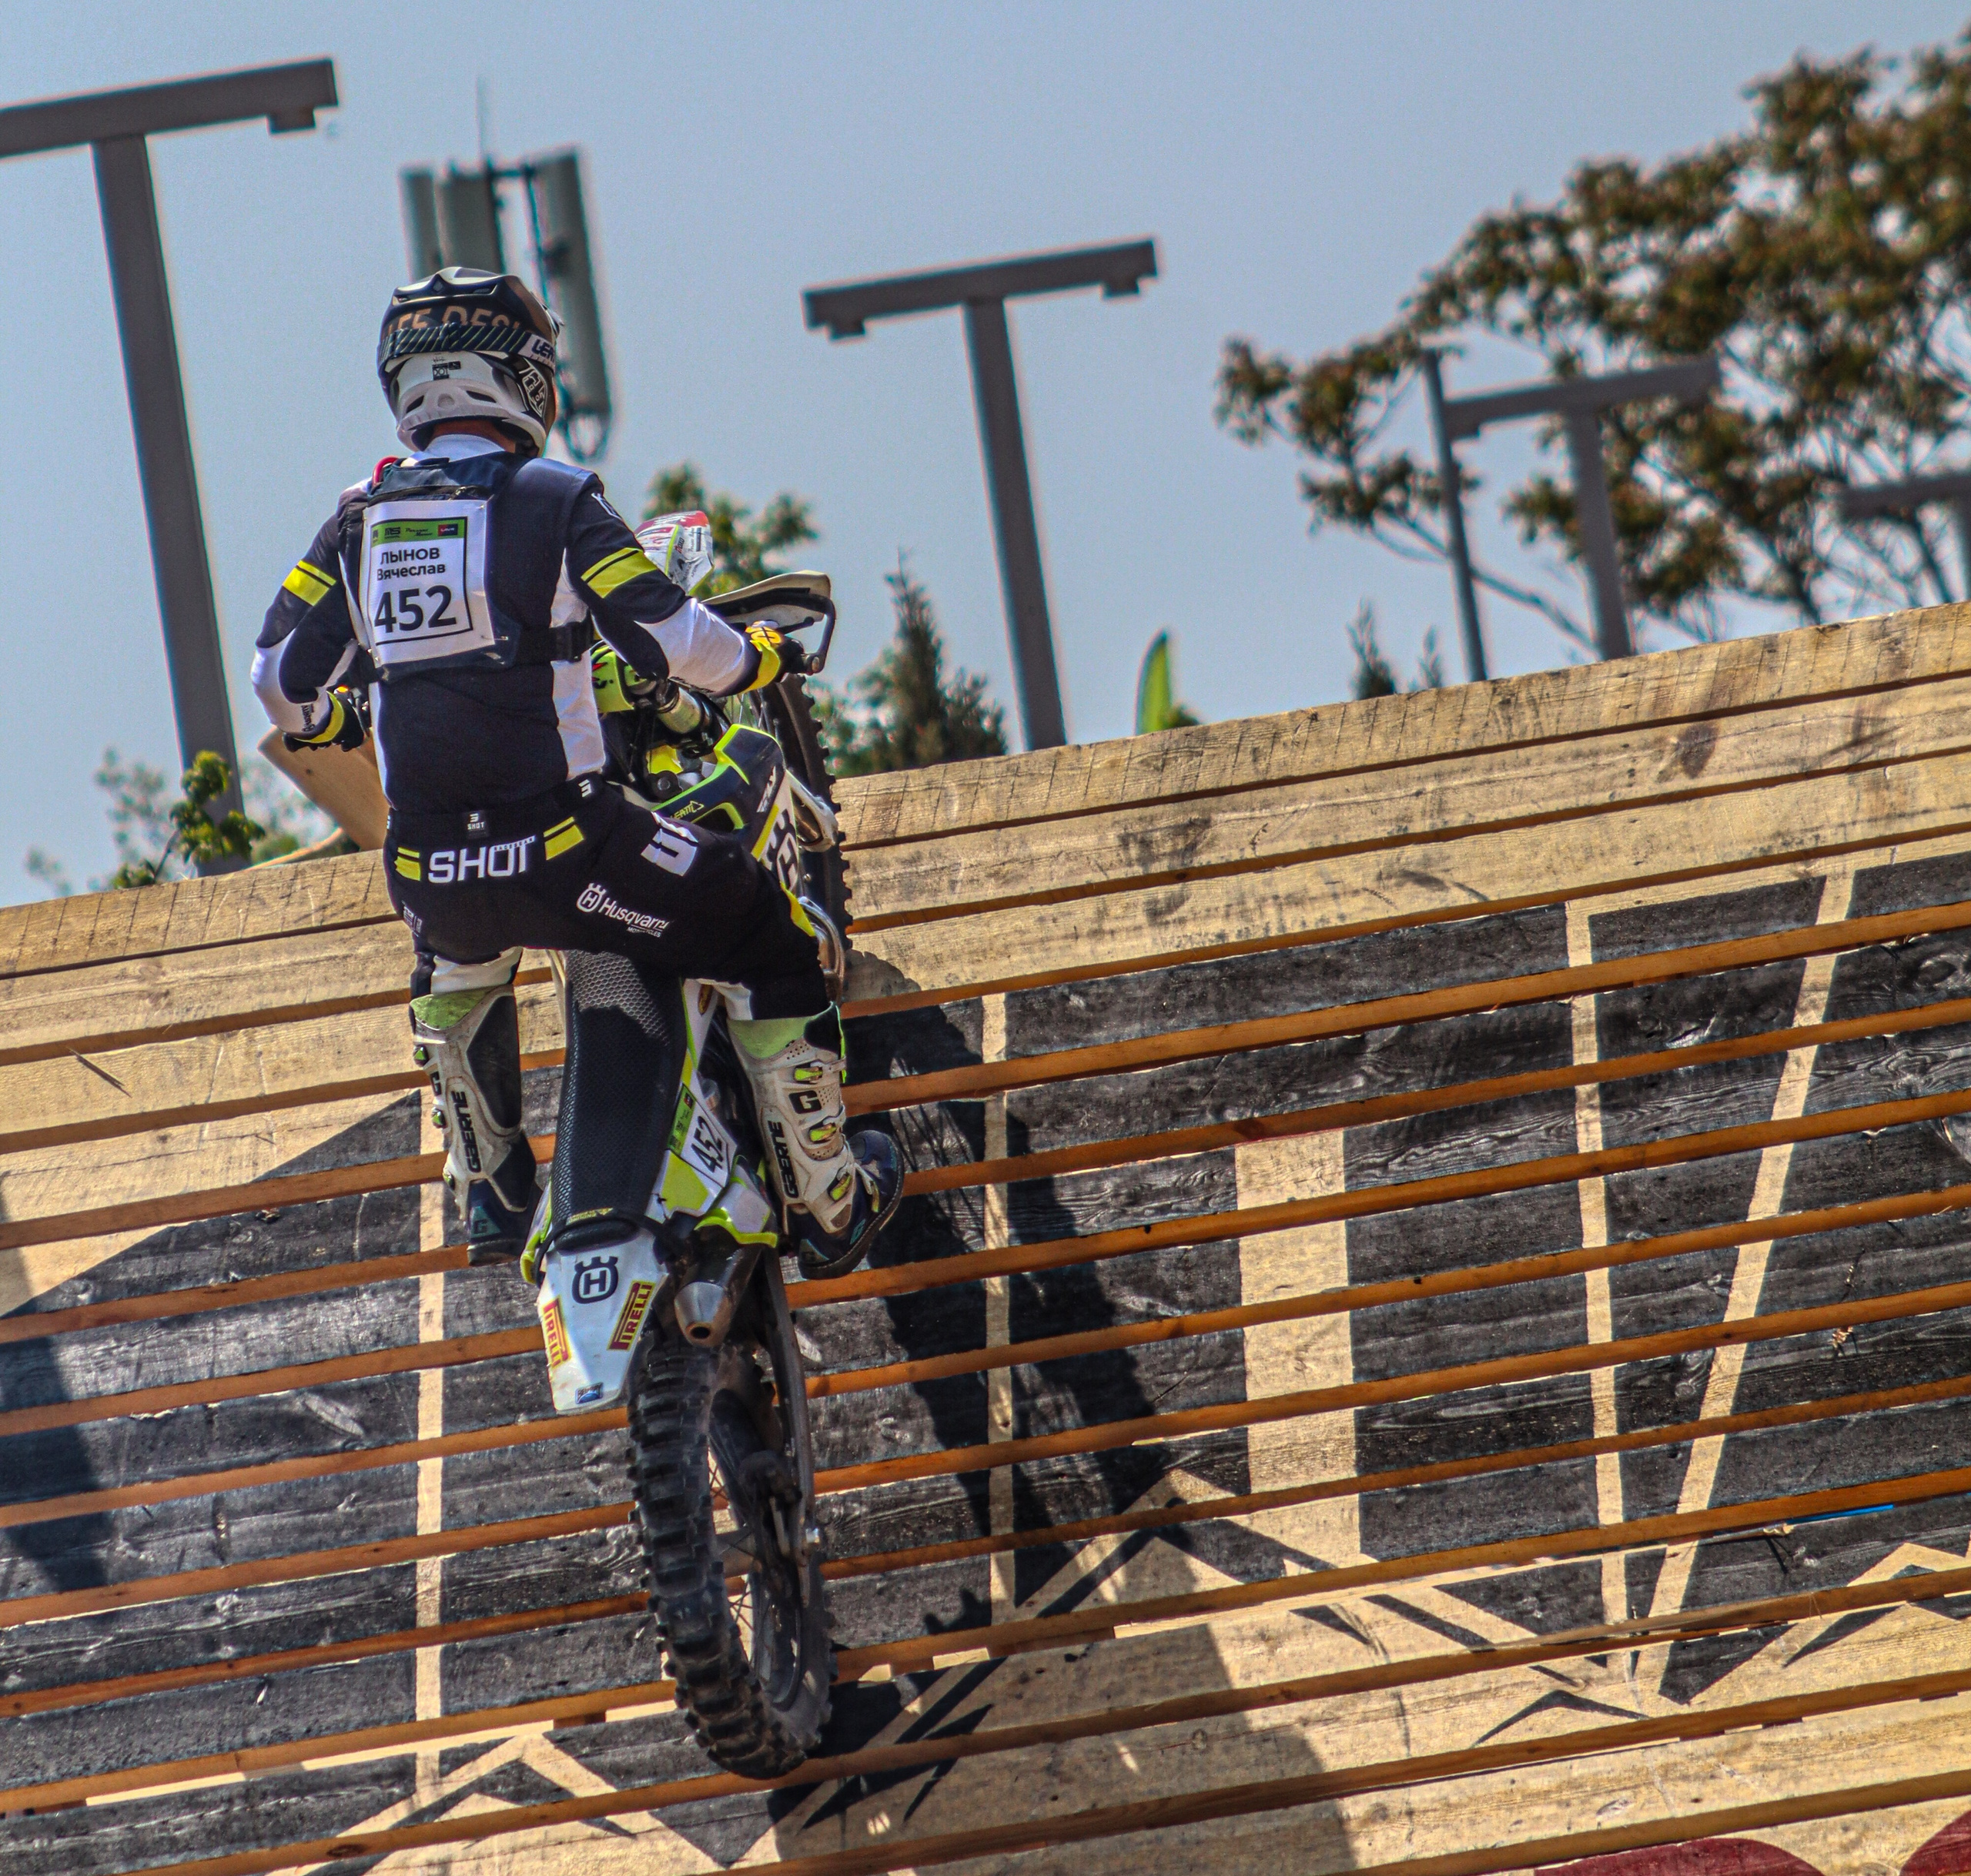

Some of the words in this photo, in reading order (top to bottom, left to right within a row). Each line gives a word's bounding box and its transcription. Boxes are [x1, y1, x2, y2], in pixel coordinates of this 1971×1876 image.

[376, 563, 446, 581] Вячеслав
[380, 547, 440, 565] ЛЫНОВ
[374, 585, 457, 634] 452
[467, 821, 485, 830] SHOT
[428, 845, 527, 884] SHOT
[691, 1115, 724, 1173] 452
[608, 1281, 654, 1349] PIRELLI
